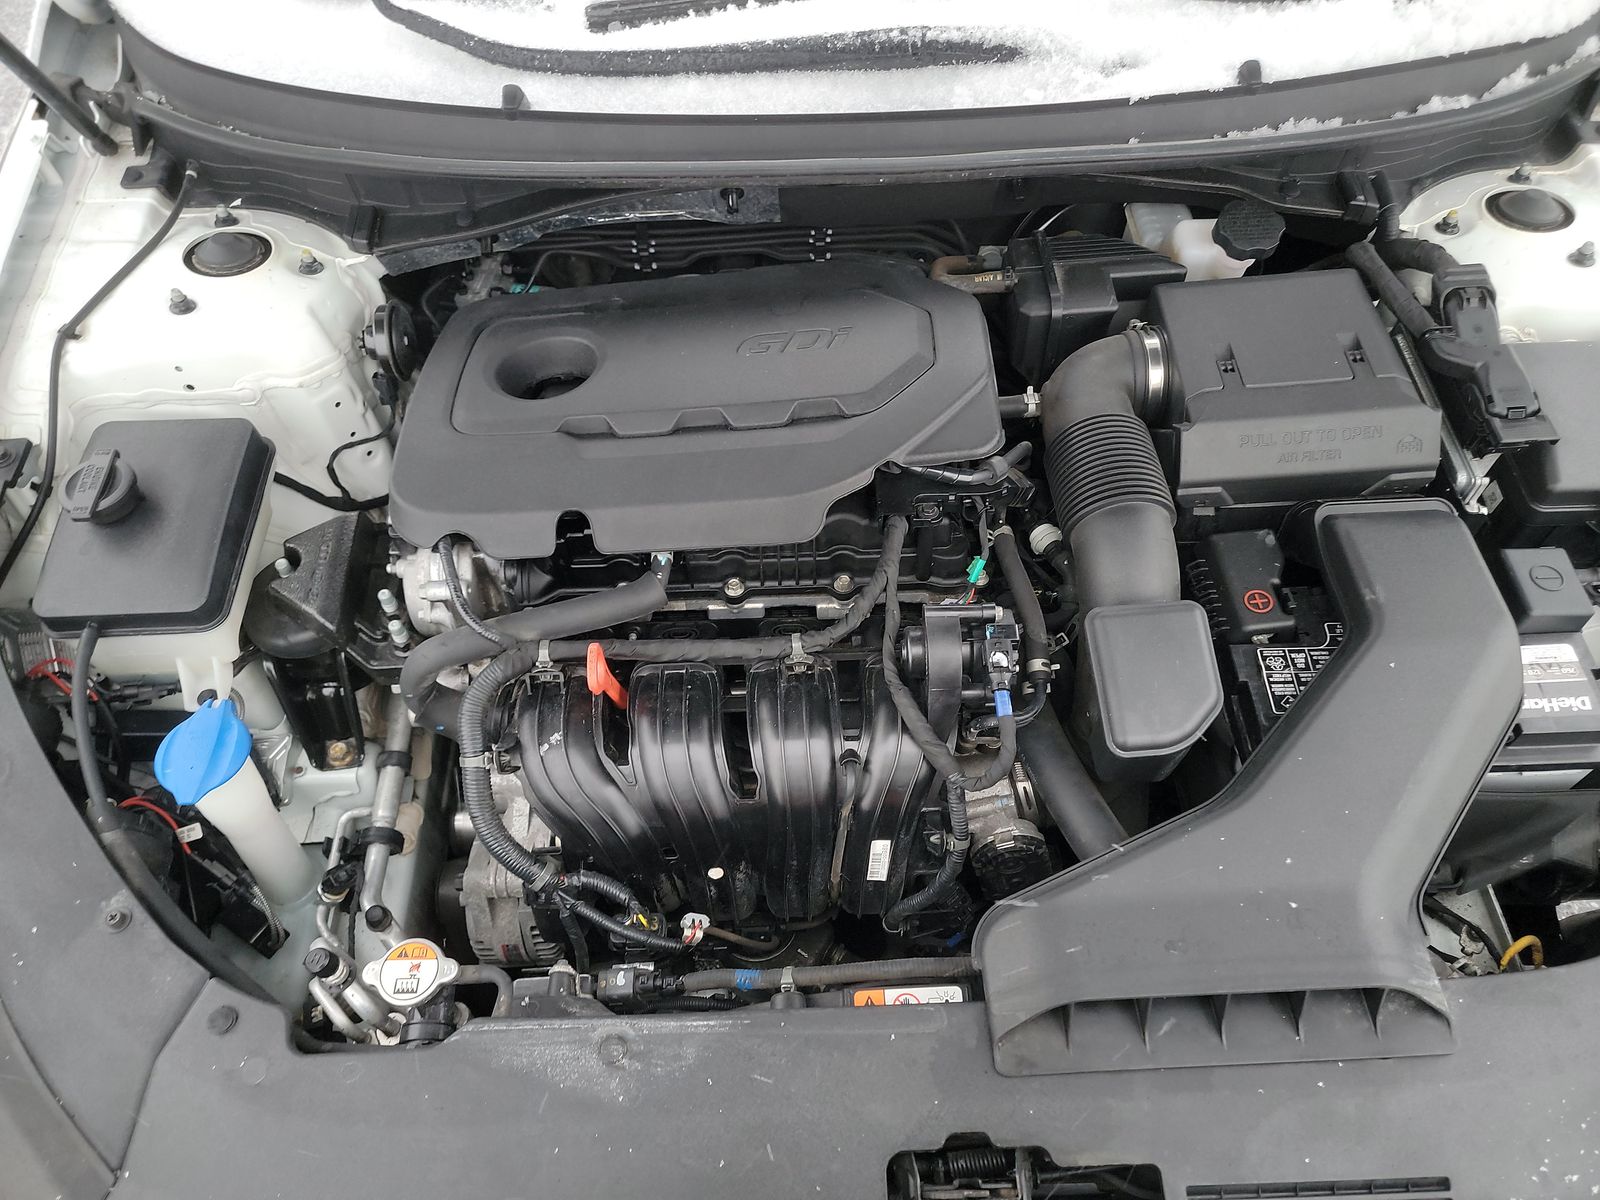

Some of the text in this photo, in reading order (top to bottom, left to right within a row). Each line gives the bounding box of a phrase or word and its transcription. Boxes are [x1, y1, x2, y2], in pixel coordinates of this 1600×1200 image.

[736, 325, 854, 355] GDi
[1239, 425, 1383, 448] PULL OUT TO OPEN
[1277, 448, 1342, 464] AIR FILTER
[1521, 696, 1593, 712] DieHar
